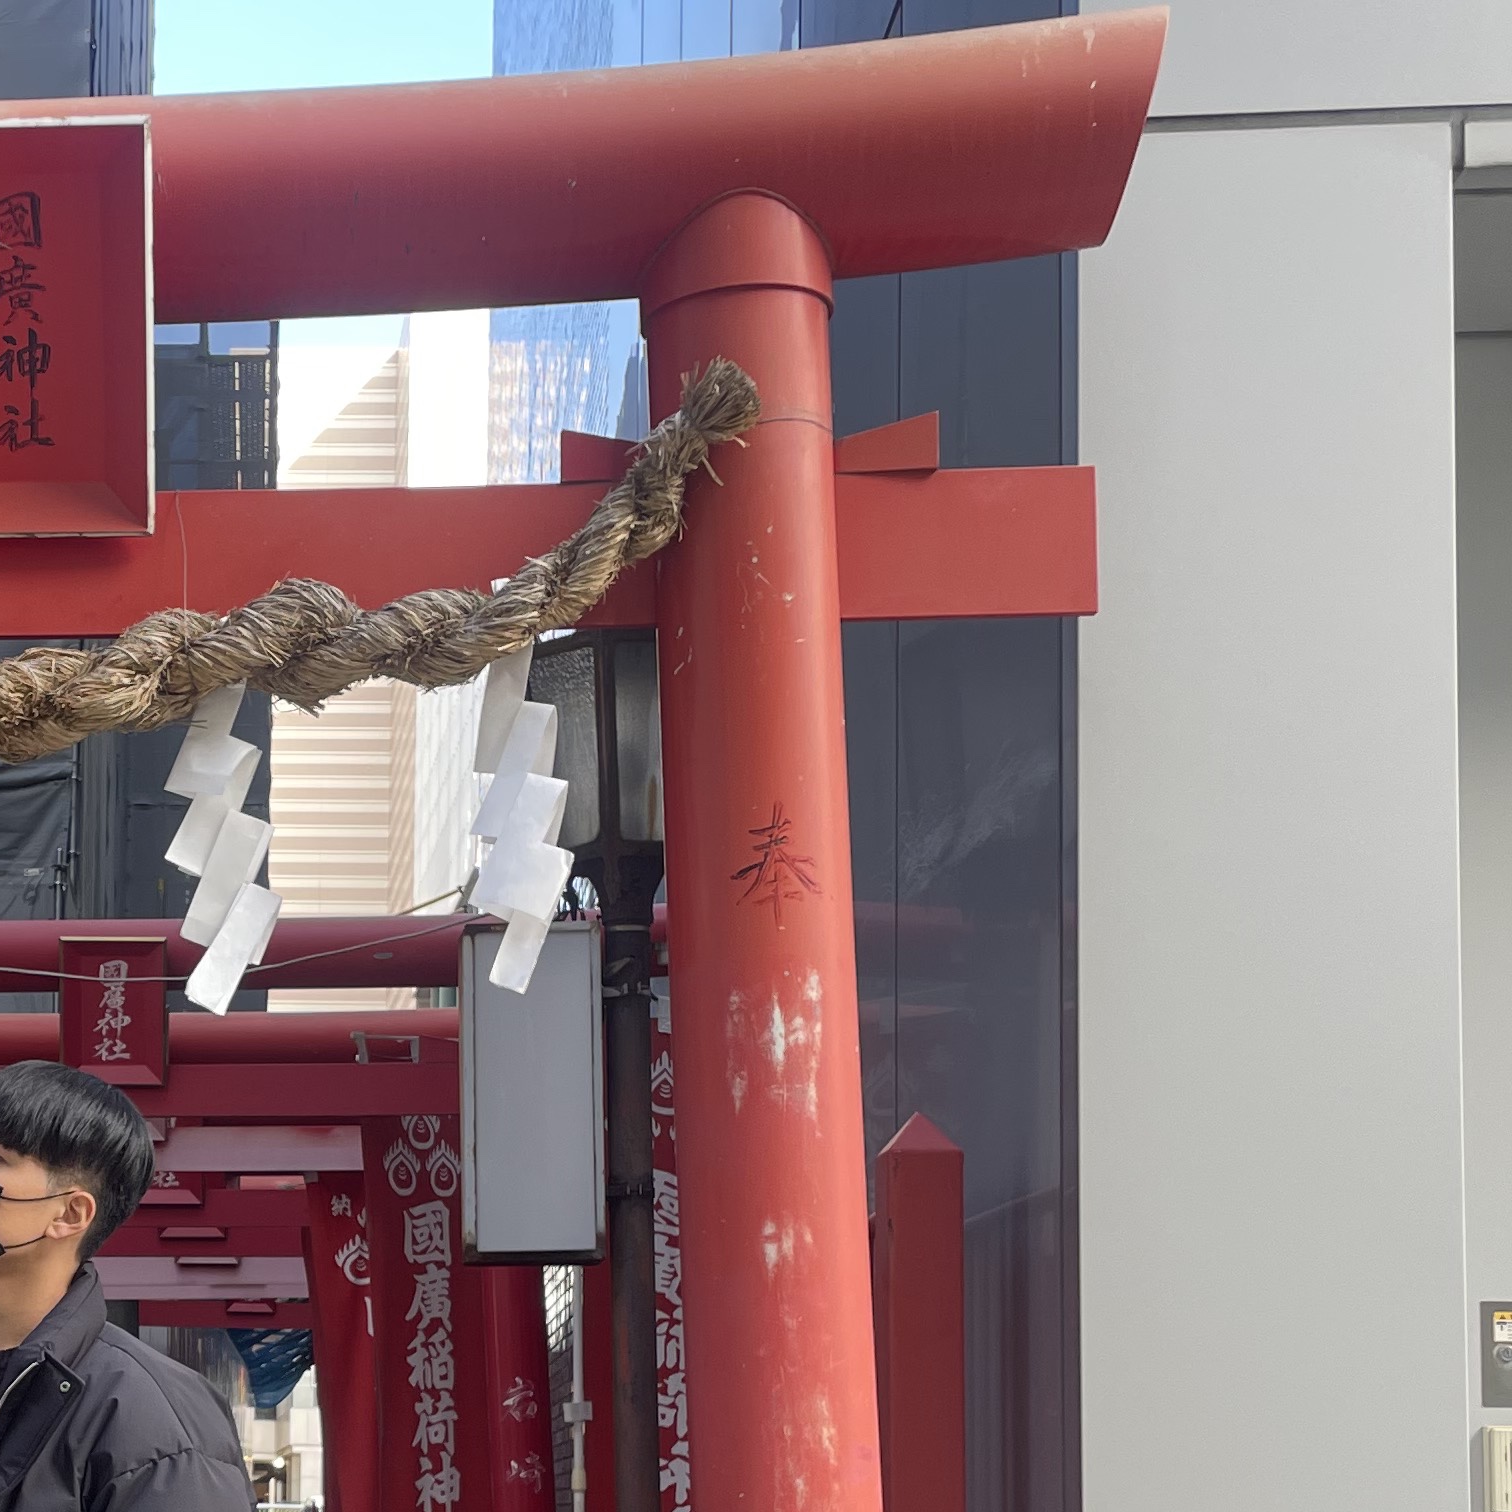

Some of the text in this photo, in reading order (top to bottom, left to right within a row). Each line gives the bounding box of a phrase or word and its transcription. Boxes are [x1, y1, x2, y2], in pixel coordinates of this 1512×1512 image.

[730, 800, 823, 927] 奉
[92, 959, 132, 1061] 國廣神社
